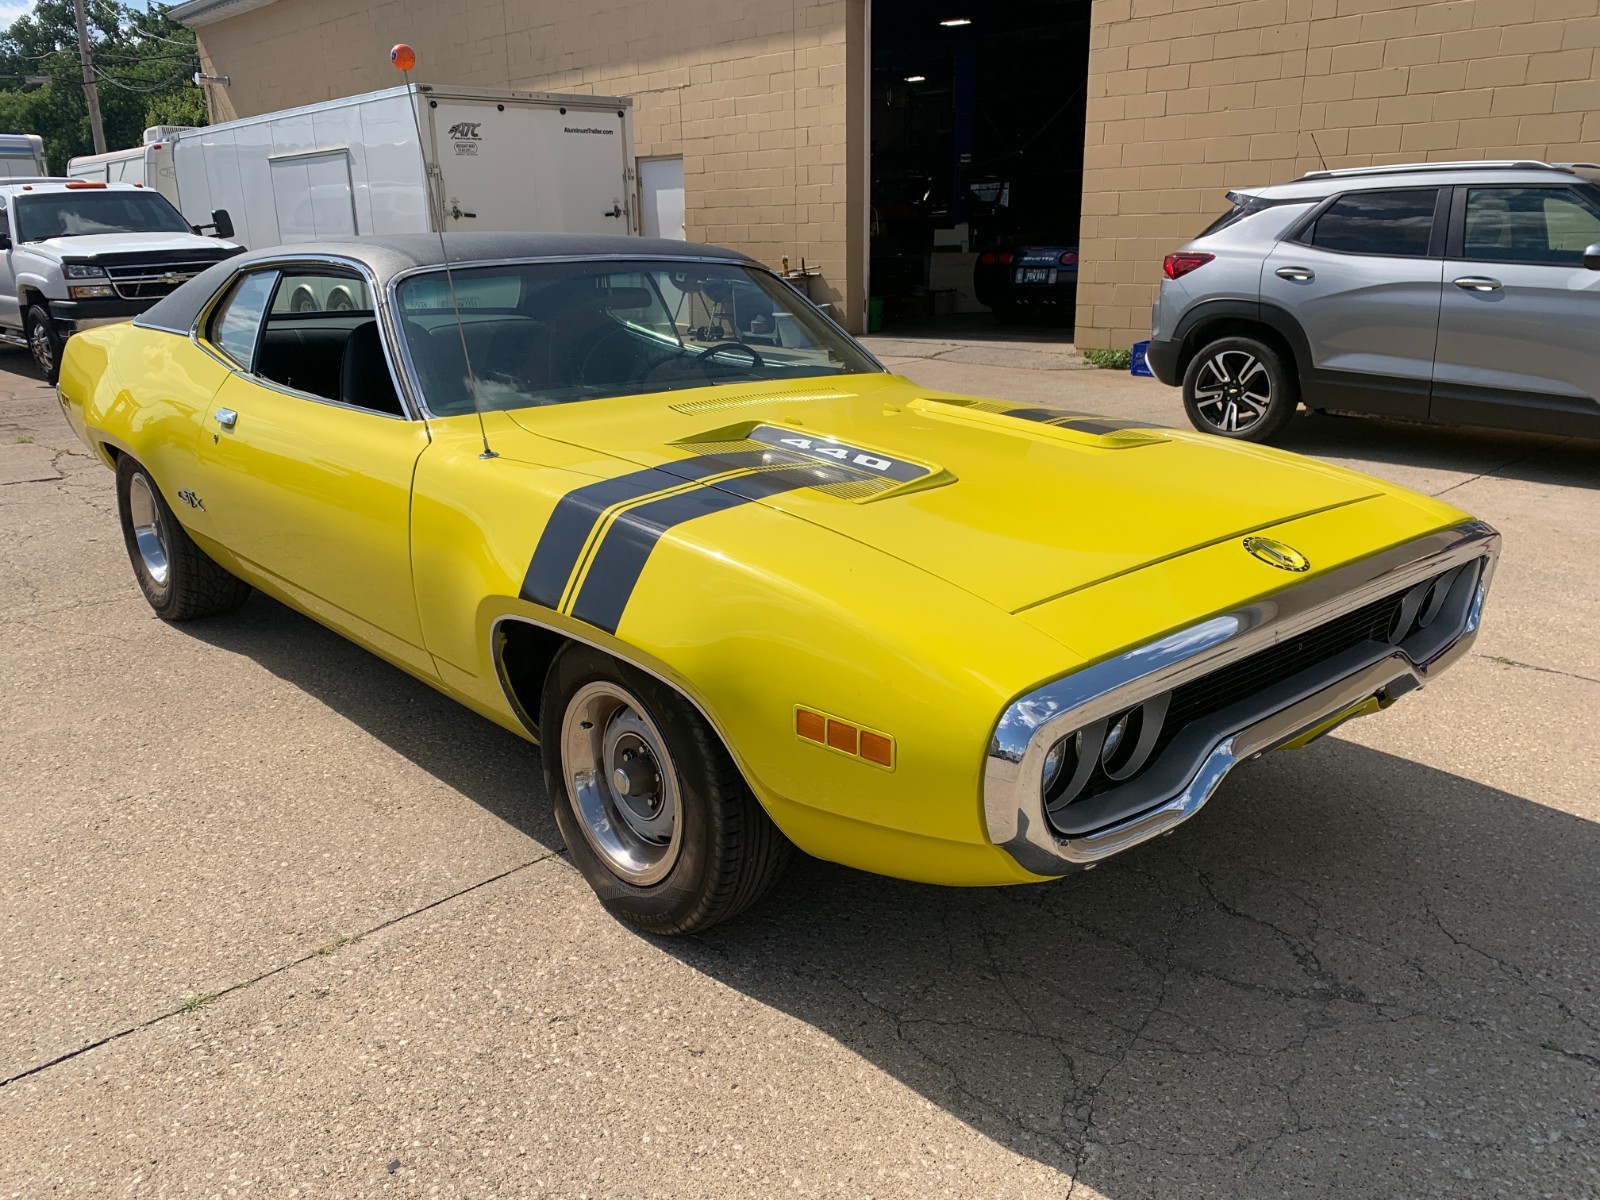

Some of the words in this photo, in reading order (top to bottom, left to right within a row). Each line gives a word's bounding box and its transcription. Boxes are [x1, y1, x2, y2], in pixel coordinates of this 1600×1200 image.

[449, 122, 482, 139] ATC
[564, 127, 613, 135] AluminumTrailer.com
[780, 438, 892, 471] 440
